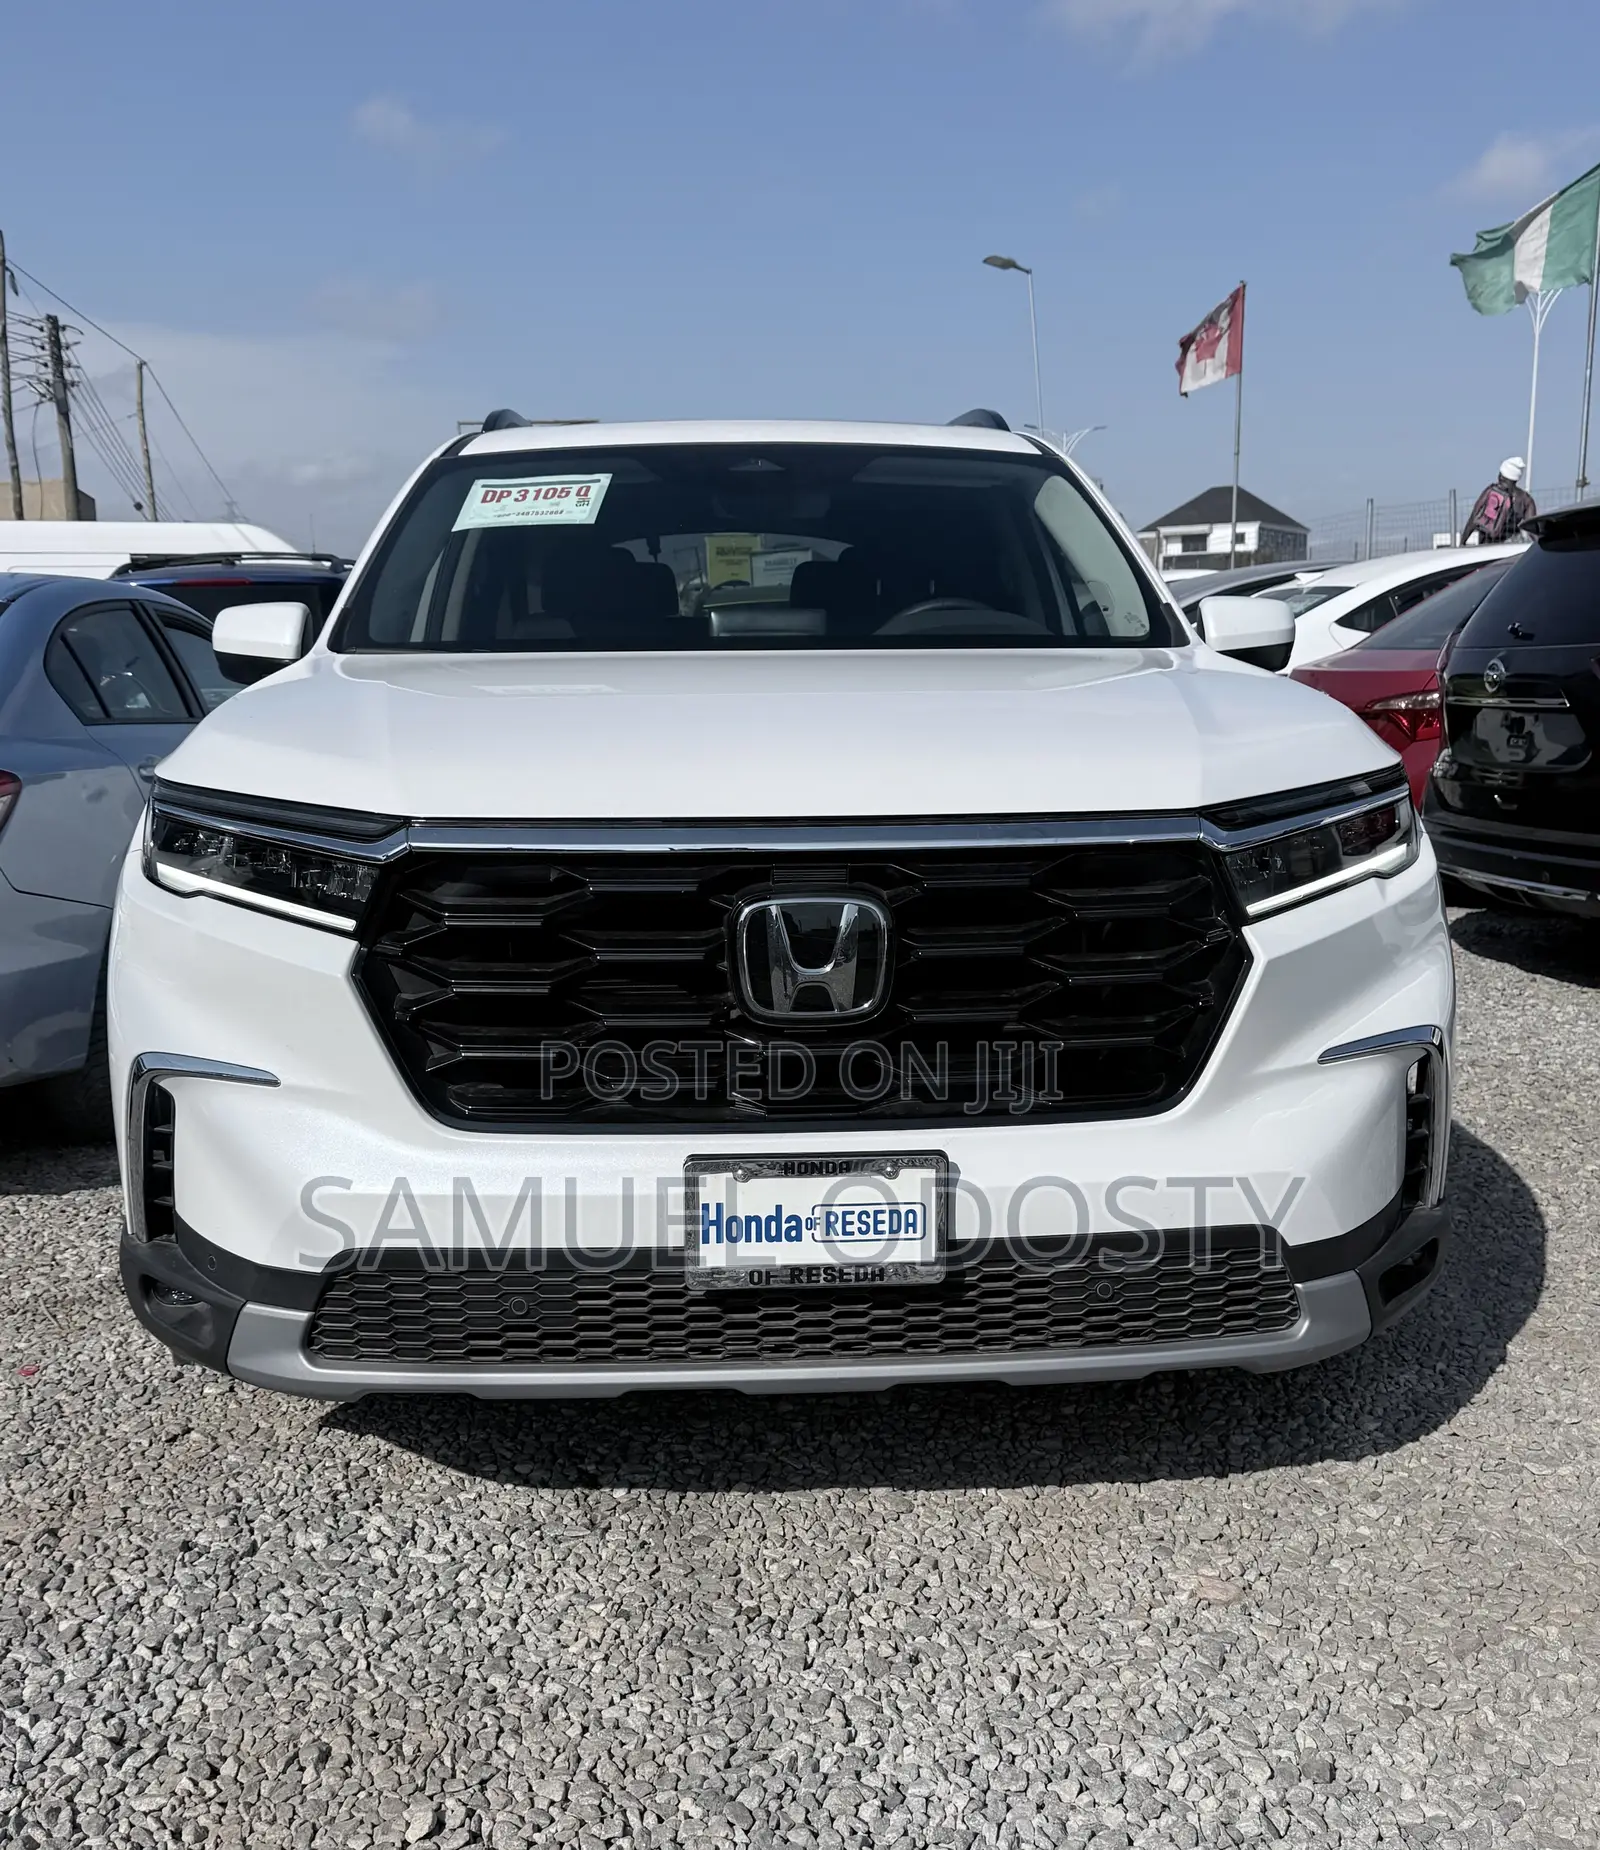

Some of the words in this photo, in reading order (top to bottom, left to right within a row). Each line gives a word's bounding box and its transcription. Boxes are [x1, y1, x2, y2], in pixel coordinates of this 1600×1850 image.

[480, 489, 513, 504] DP
[513, 486, 573, 503] 3105
[575, 485, 591, 498] Q
[783, 1160, 850, 1176] HONDA
[701, 1202, 803, 1245] Honda
[805, 1216, 821, 1232] OF
[825, 1208, 918, 1237] RESEDA
[749, 1269, 775, 1286] OF
[789, 1265, 886, 1284] RESEDA
